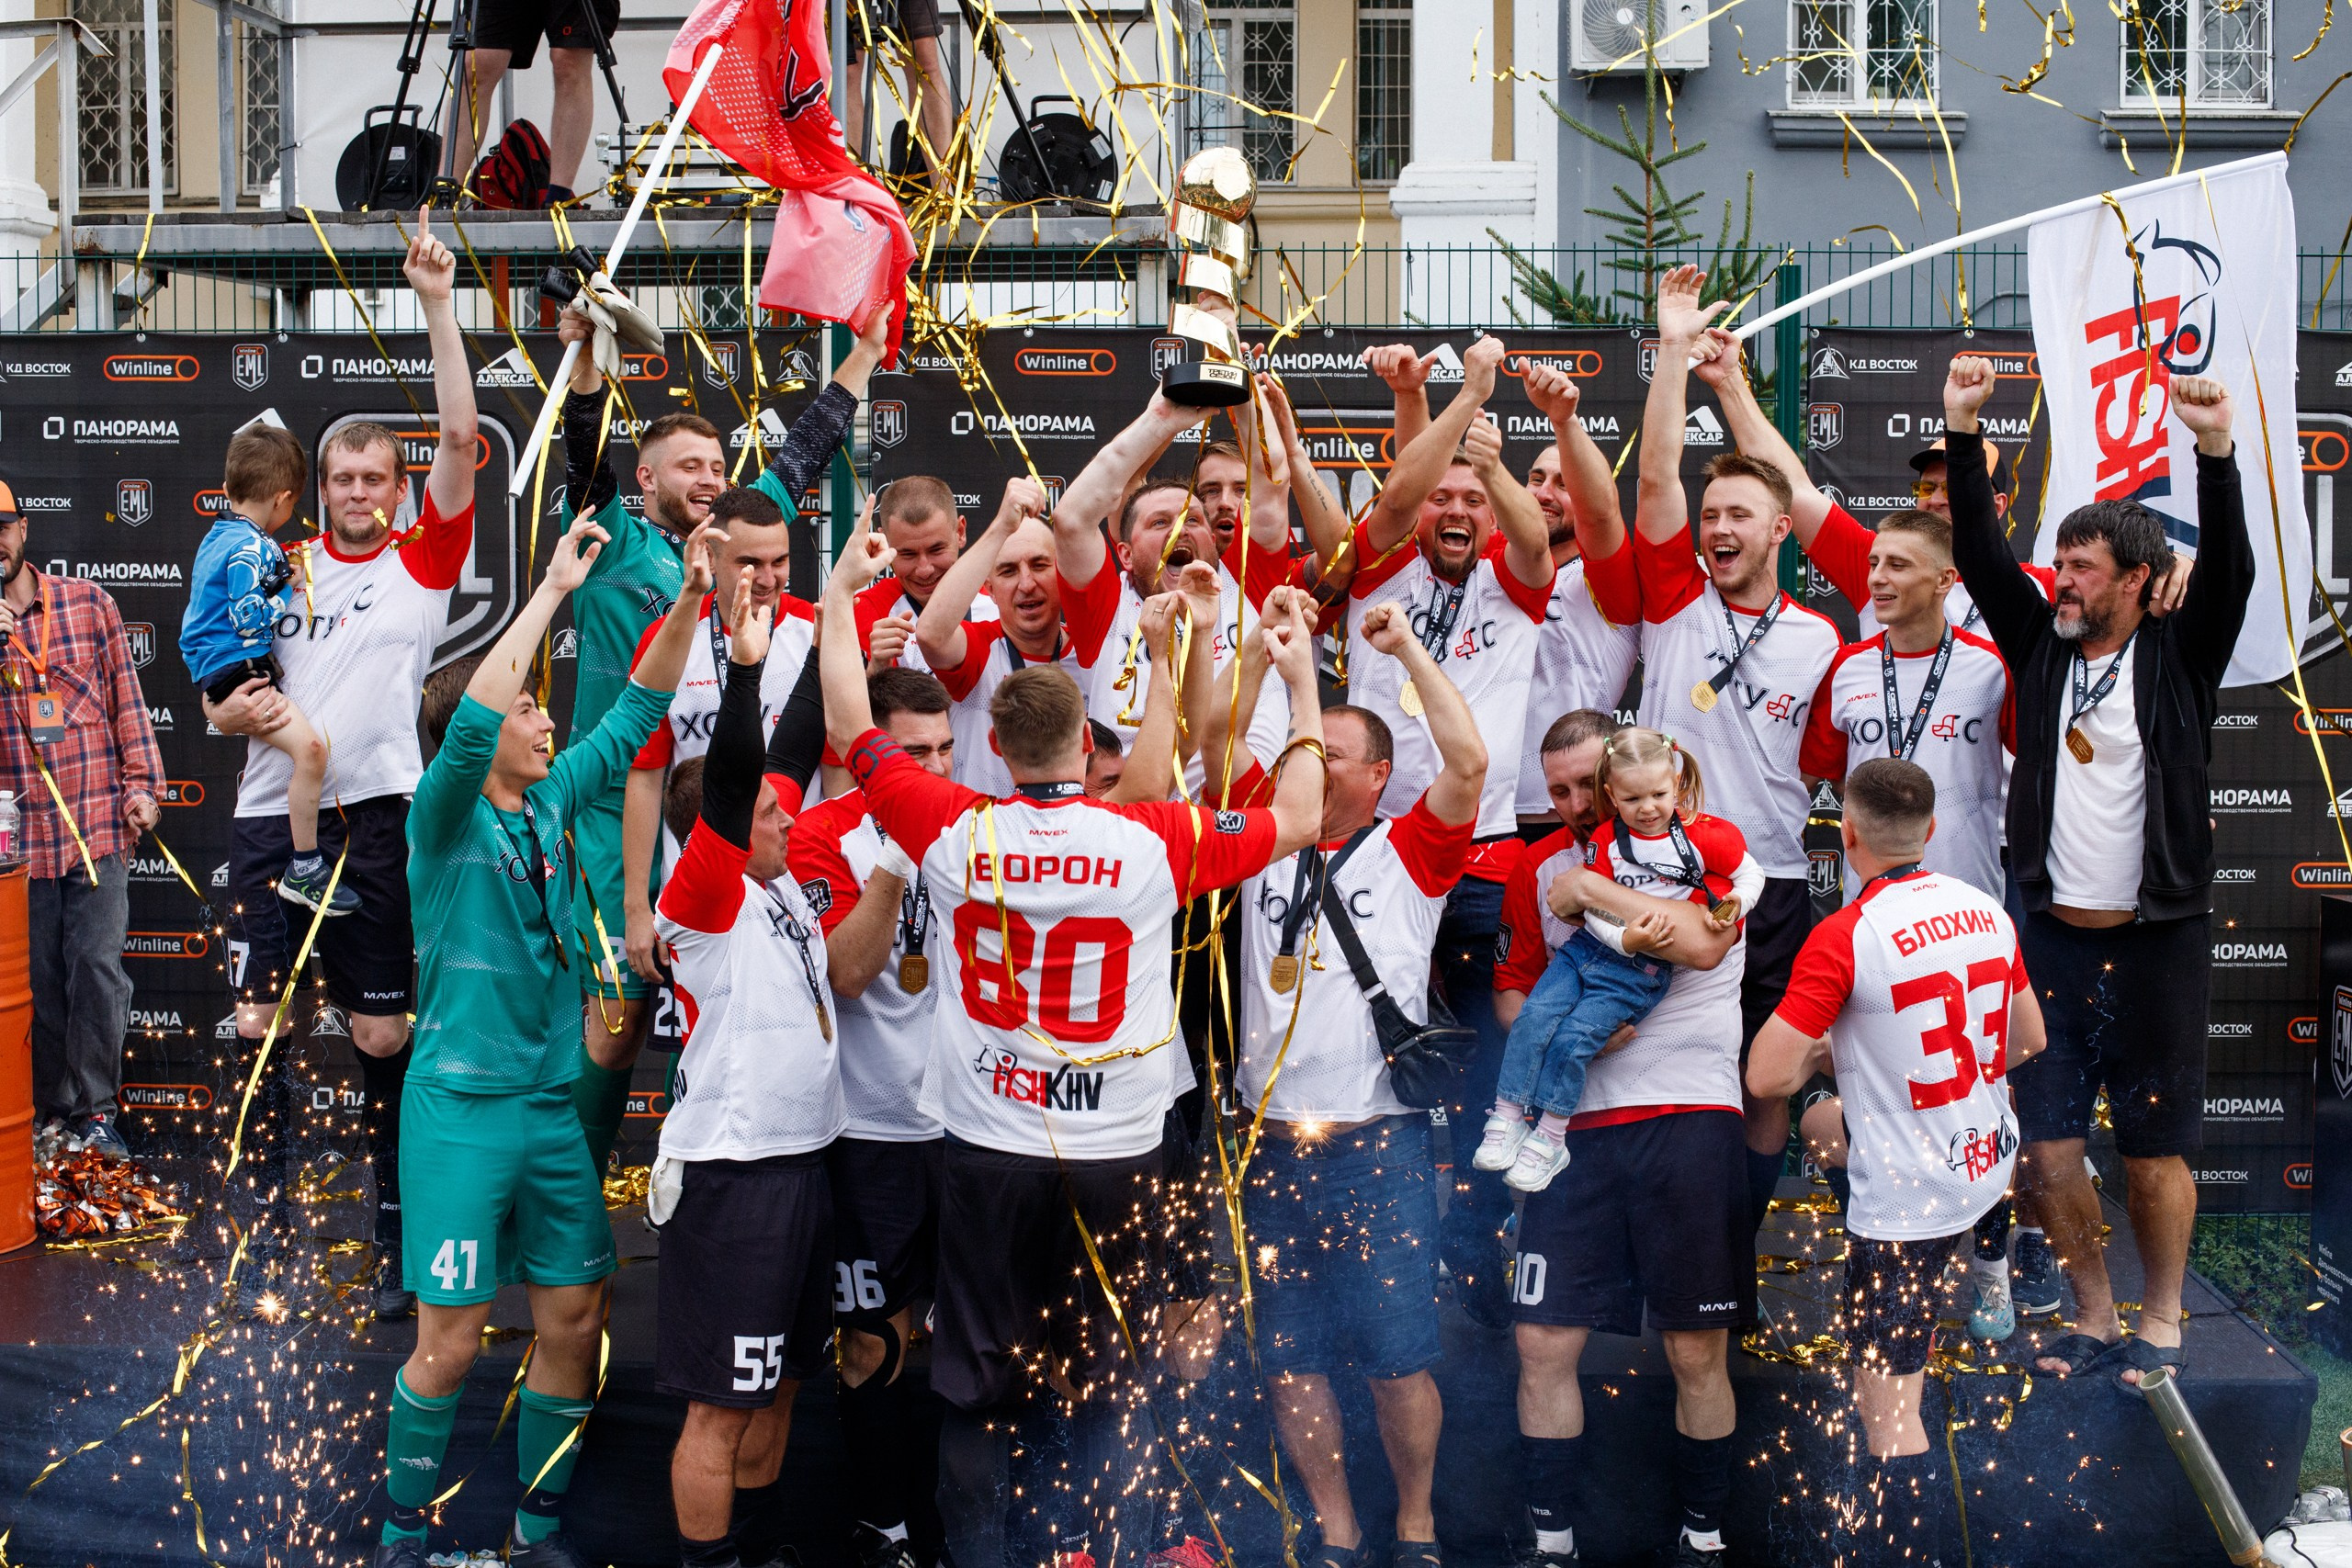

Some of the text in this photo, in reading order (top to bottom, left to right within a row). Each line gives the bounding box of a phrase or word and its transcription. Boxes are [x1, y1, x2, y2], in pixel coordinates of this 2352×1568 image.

[6, 363, 72, 374] КД ВОСТОК
[112, 361, 173, 375] Winline
[235, 355, 266, 378] EML
[333, 359, 435, 375] ПАНОРАМА
[1023, 355, 1087, 369] Winline
[1259, 355, 1367, 369] ПАНОРАМА
[1849, 359, 1917, 369] КД ВОСТОК
[476, 374, 535, 384] АЛЕКСАР
[74, 420, 180, 436] ПАНОРАМА
[874, 414, 903, 434] EML
[984, 415, 1095, 432] ПАНОРАМА
[1810, 413, 1838, 436] EML
[1684, 432, 1724, 441] ЕКСАР
[26, 497, 72, 508] ВОСТОК
[120, 490, 149, 513] EML
[1849, 497, 1917, 507] КД ВОСТОК
[76, 563, 183, 580] ПАНОРАМА
[1846, 692, 1878, 704] MAVEX
[2210, 789, 2292, 806] НОРАМА
[975, 852, 1123, 889] ВОРОН
[1807, 861, 1837, 884] EML
[2301, 869, 2352, 882] Winlin
[915, 896, 924, 929] СЕЗОН
[1891, 908, 1997, 957] БЛОХИН
[124, 938, 181, 953] Winline
[2211, 943, 2288, 960] НОРАМА
[954, 899, 1134, 1043] 80
[364, 989, 405, 999] MAVEX
[1891, 956, 2013, 1111] 33
[2203, 1098, 2284, 1114] НОРАМА
[2201, 1170, 2248, 1180] ВОСТОК
[429, 1238, 478, 1291] 41
[732, 1332, 786, 1392] 55
